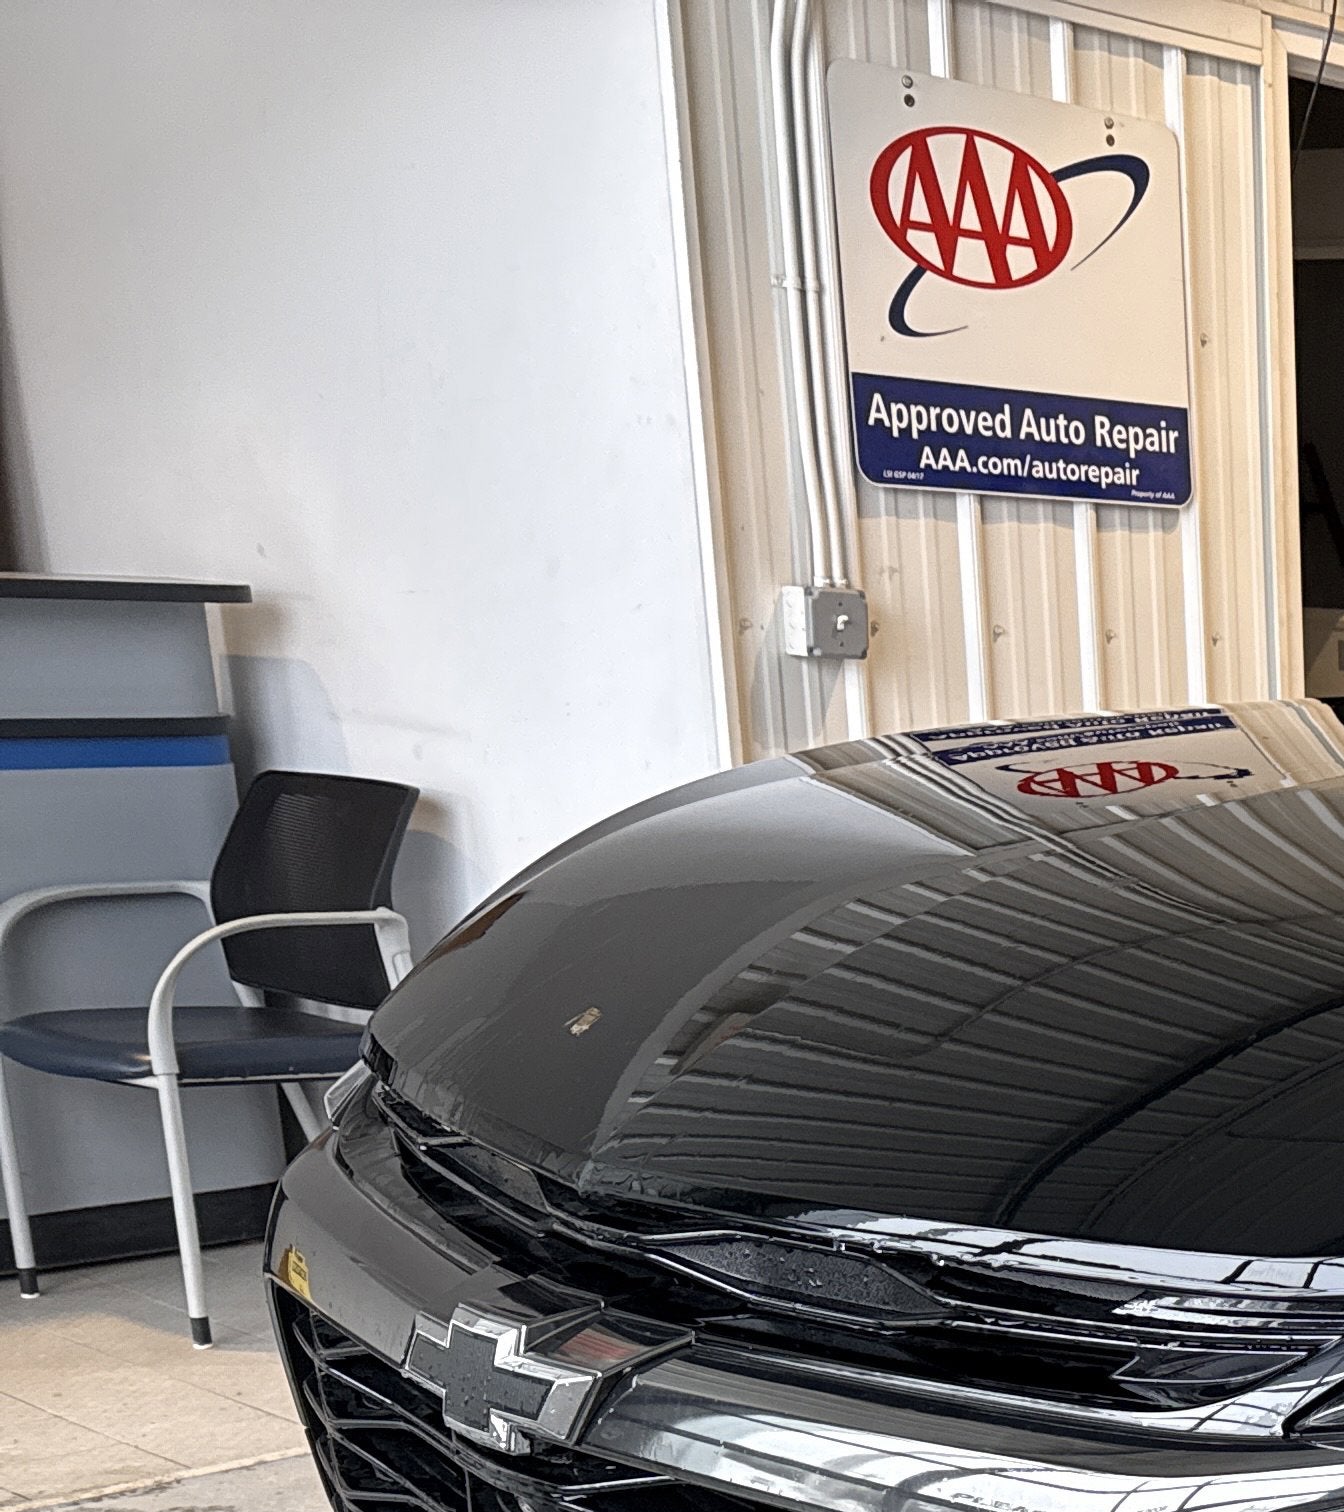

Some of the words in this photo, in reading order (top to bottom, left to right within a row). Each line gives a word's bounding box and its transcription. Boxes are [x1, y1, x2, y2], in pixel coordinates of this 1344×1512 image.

[878, 130, 1066, 288] AAA
[867, 392, 1012, 440] Approved
[1019, 408, 1086, 445] Auto
[1094, 415, 1180, 458] Repair
[919, 446, 1140, 487] AAA.com/autorepair
